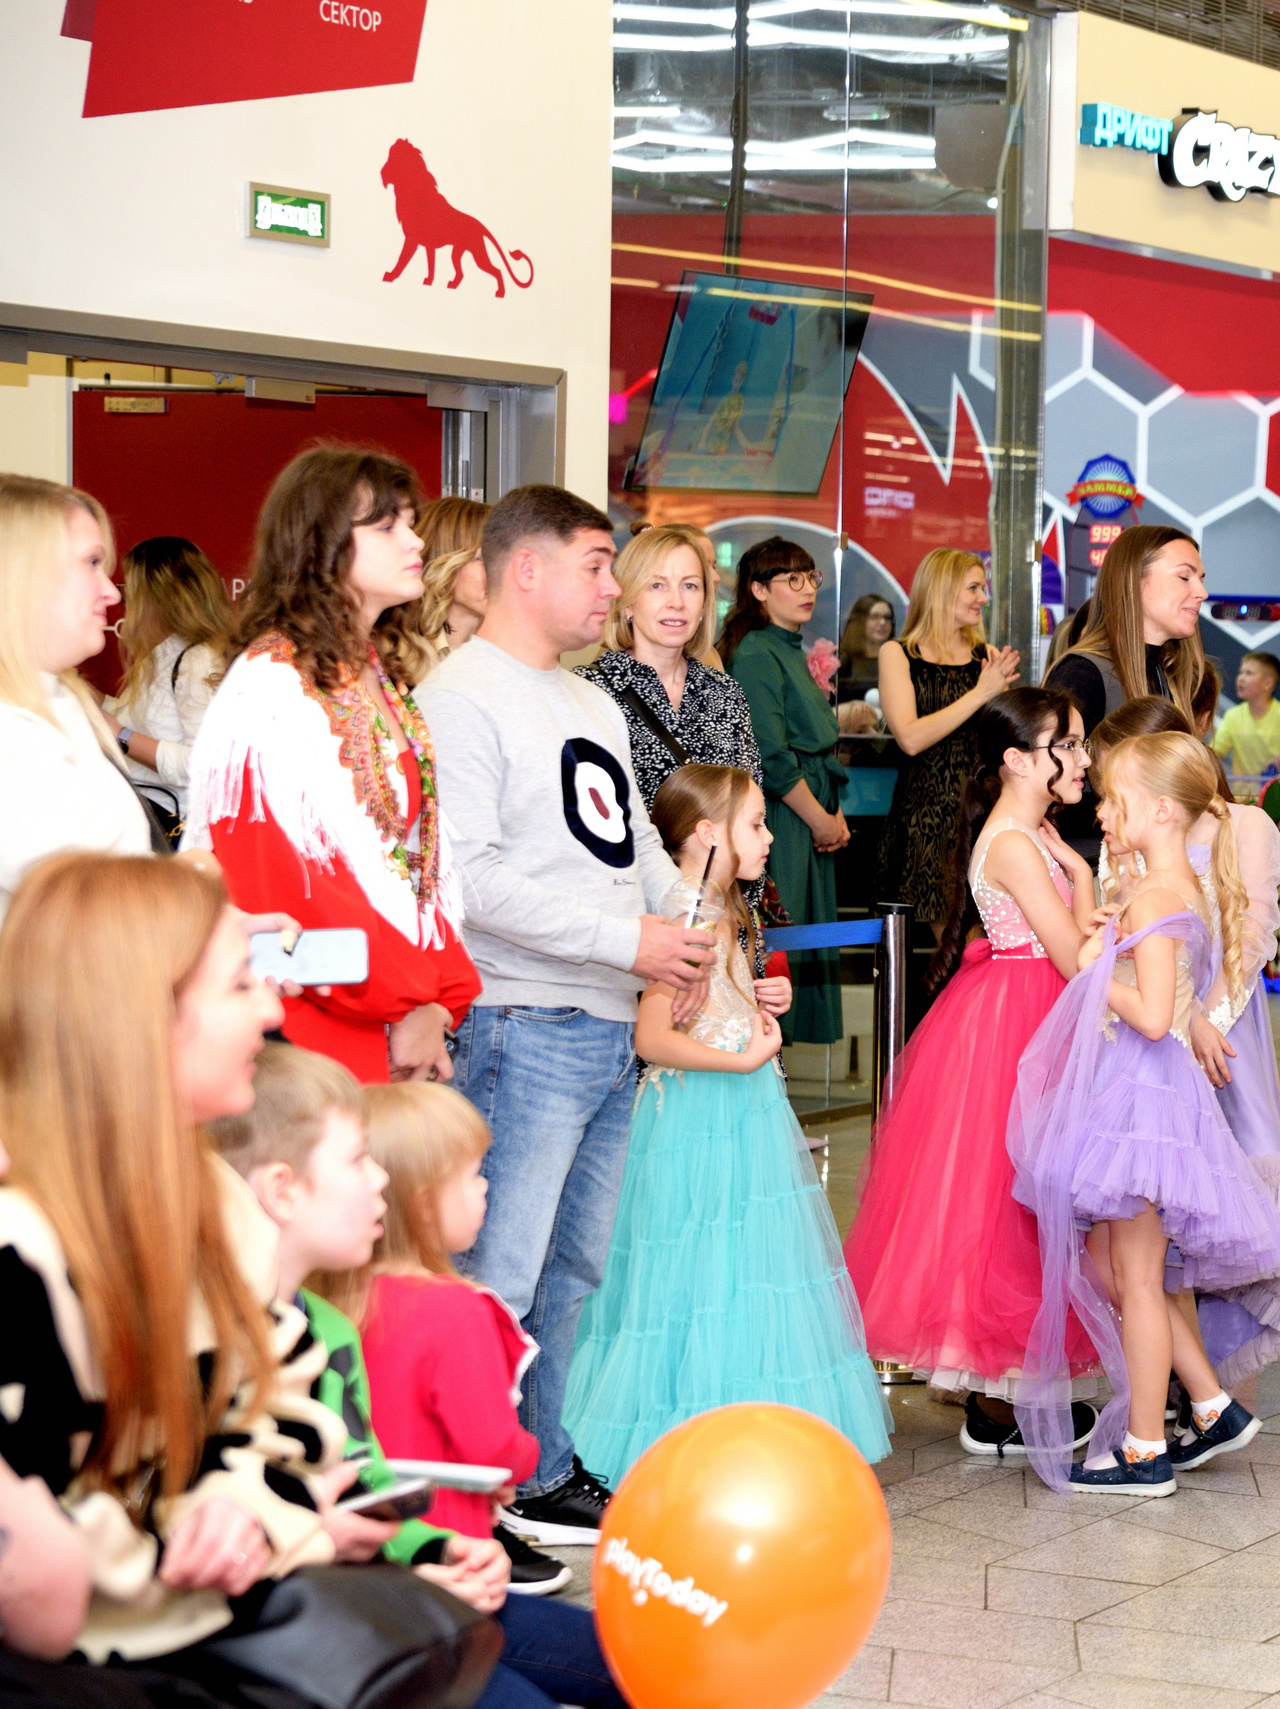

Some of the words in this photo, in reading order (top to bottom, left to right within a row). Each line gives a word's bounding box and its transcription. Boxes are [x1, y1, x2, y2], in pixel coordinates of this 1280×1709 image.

[319, 0, 382, 32] СЕКТОР
[1094, 101, 1174, 156] ДРИФТ
[1089, 524, 1122, 543] 999
